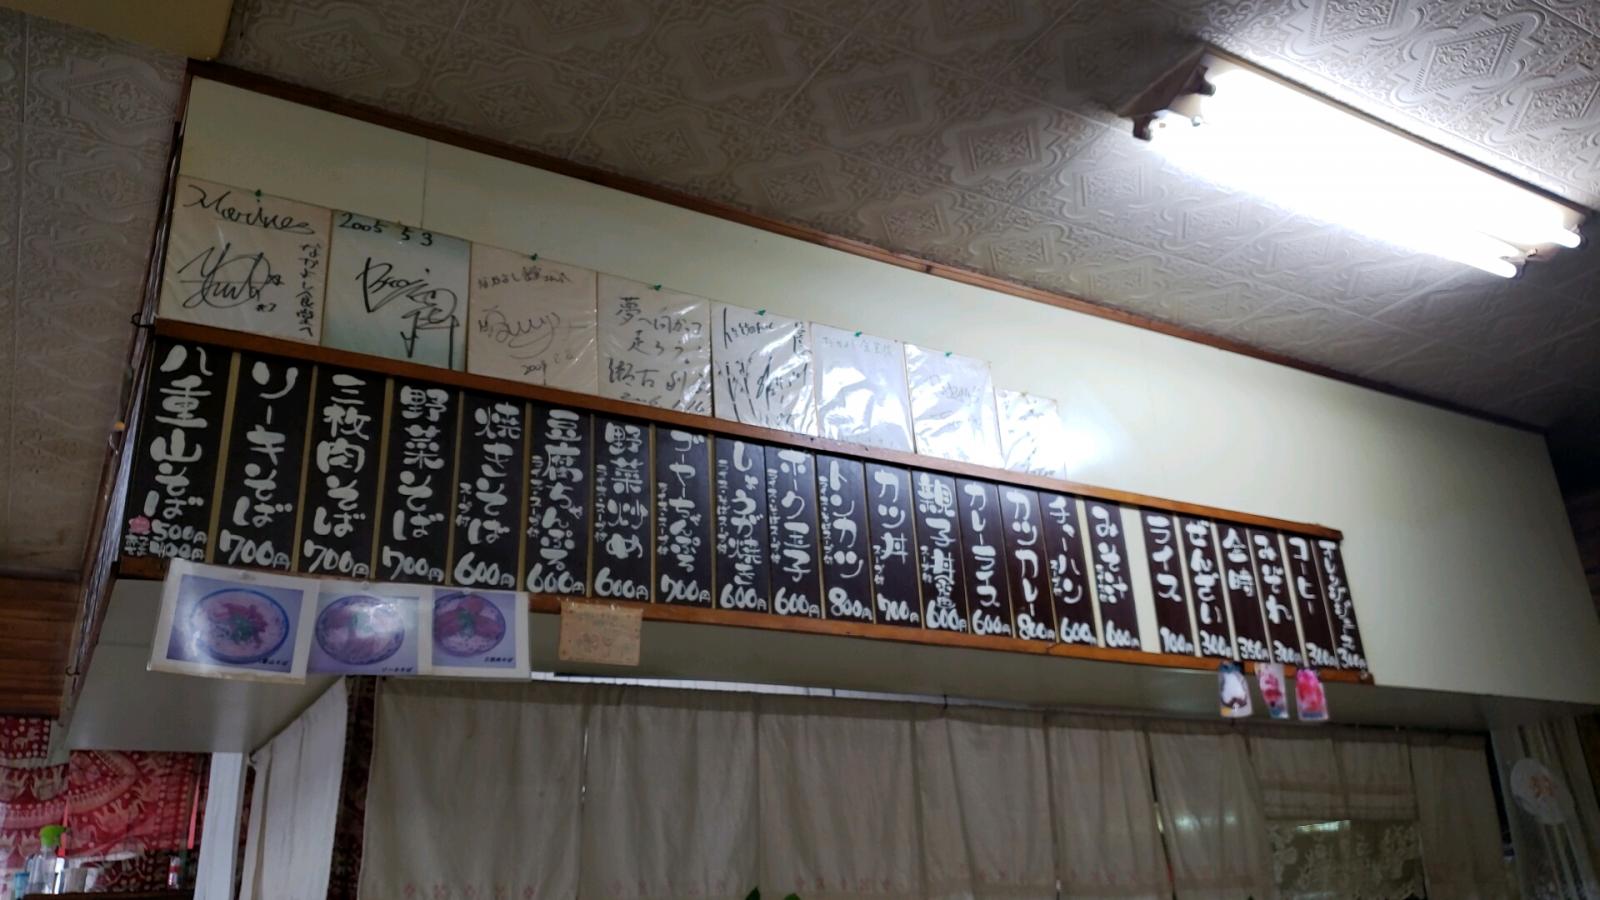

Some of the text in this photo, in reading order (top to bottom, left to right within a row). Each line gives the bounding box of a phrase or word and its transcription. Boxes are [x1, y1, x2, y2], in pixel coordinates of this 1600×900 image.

[338, 212, 386, 234] 2005
[144, 345, 213, 519] 八重山そば
[233, 361, 299, 528] ソーキそば
[313, 374, 371, 538] 三枚肉そば
[393, 385, 449, 541] 野菜そば
[468, 402, 522, 544] 焼きそば
[828, 460, 864, 578] トンカツ
[874, 469, 909, 565] カツ丼
[964, 482, 1001, 607] カレーライス
[219, 529, 291, 570] 700円
[303, 539, 370, 577] 700円
[382, 546, 445, 582] 700円
[454, 552, 515, 587] 600円
[527, 563, 586, 594] 600円
[1006, 490, 1039, 617] カツカレー
[1146, 515, 1183, 602] ライス
[1288, 537, 1318, 615] コーヒー
[594, 567, 649, 600] 600円
[660, 574, 711, 602] 700円
[720, 583, 767, 611] 600円
[774, 586, 820, 618] 600円
[828, 587, 873, 621] 800円
